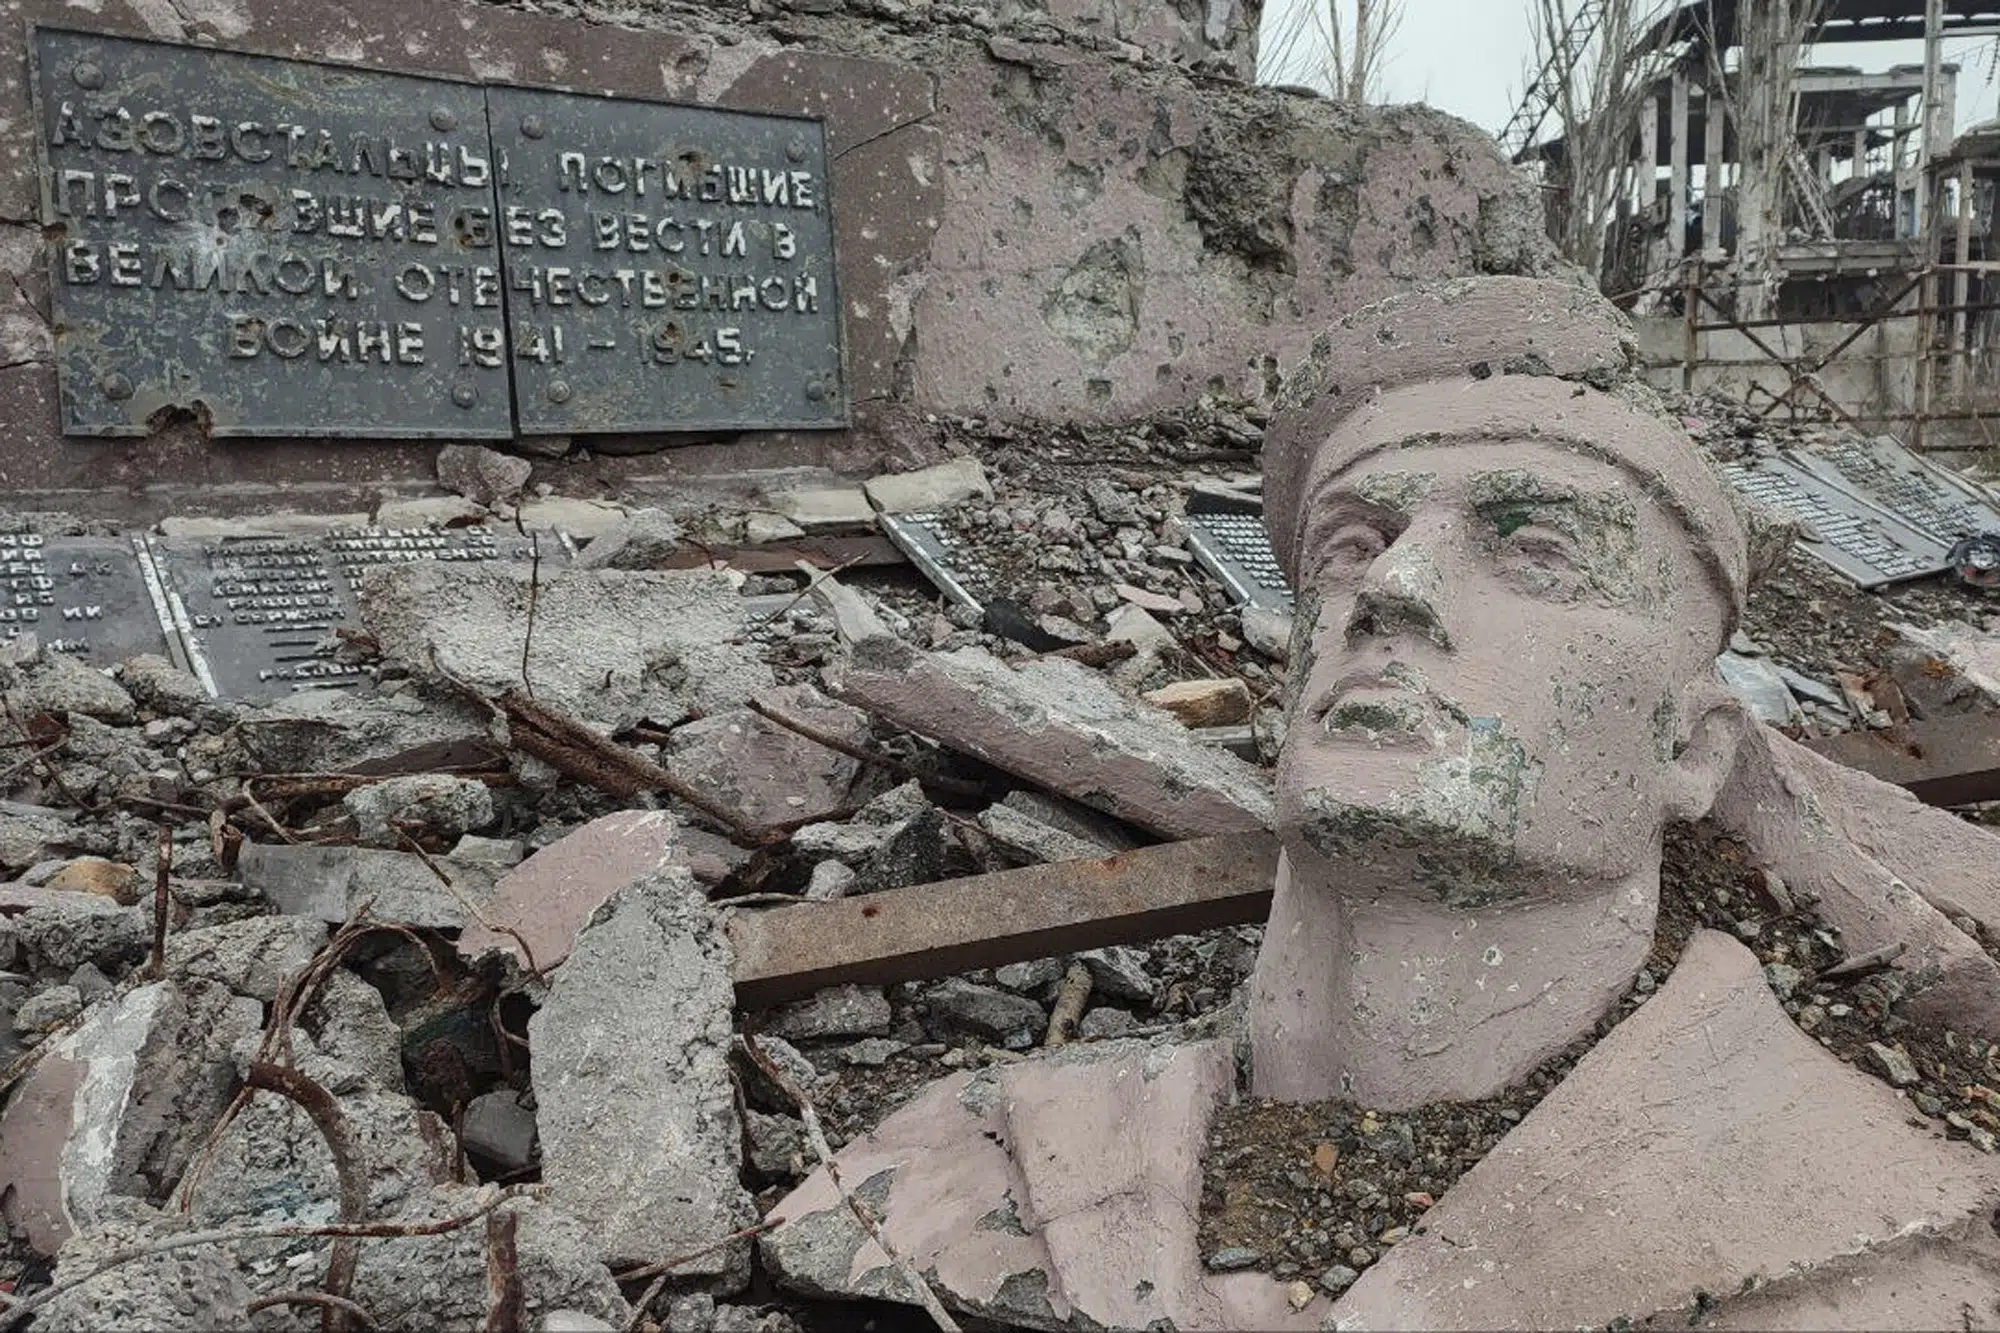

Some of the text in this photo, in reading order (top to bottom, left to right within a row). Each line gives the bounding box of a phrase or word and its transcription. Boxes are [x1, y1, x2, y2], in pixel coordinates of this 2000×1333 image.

[456, 205, 567, 248] БЕЗ
[593, 211, 747, 257] ВЕСТИ
[775, 222, 797, 259] В
[459, 321, 562, 367] 1941
